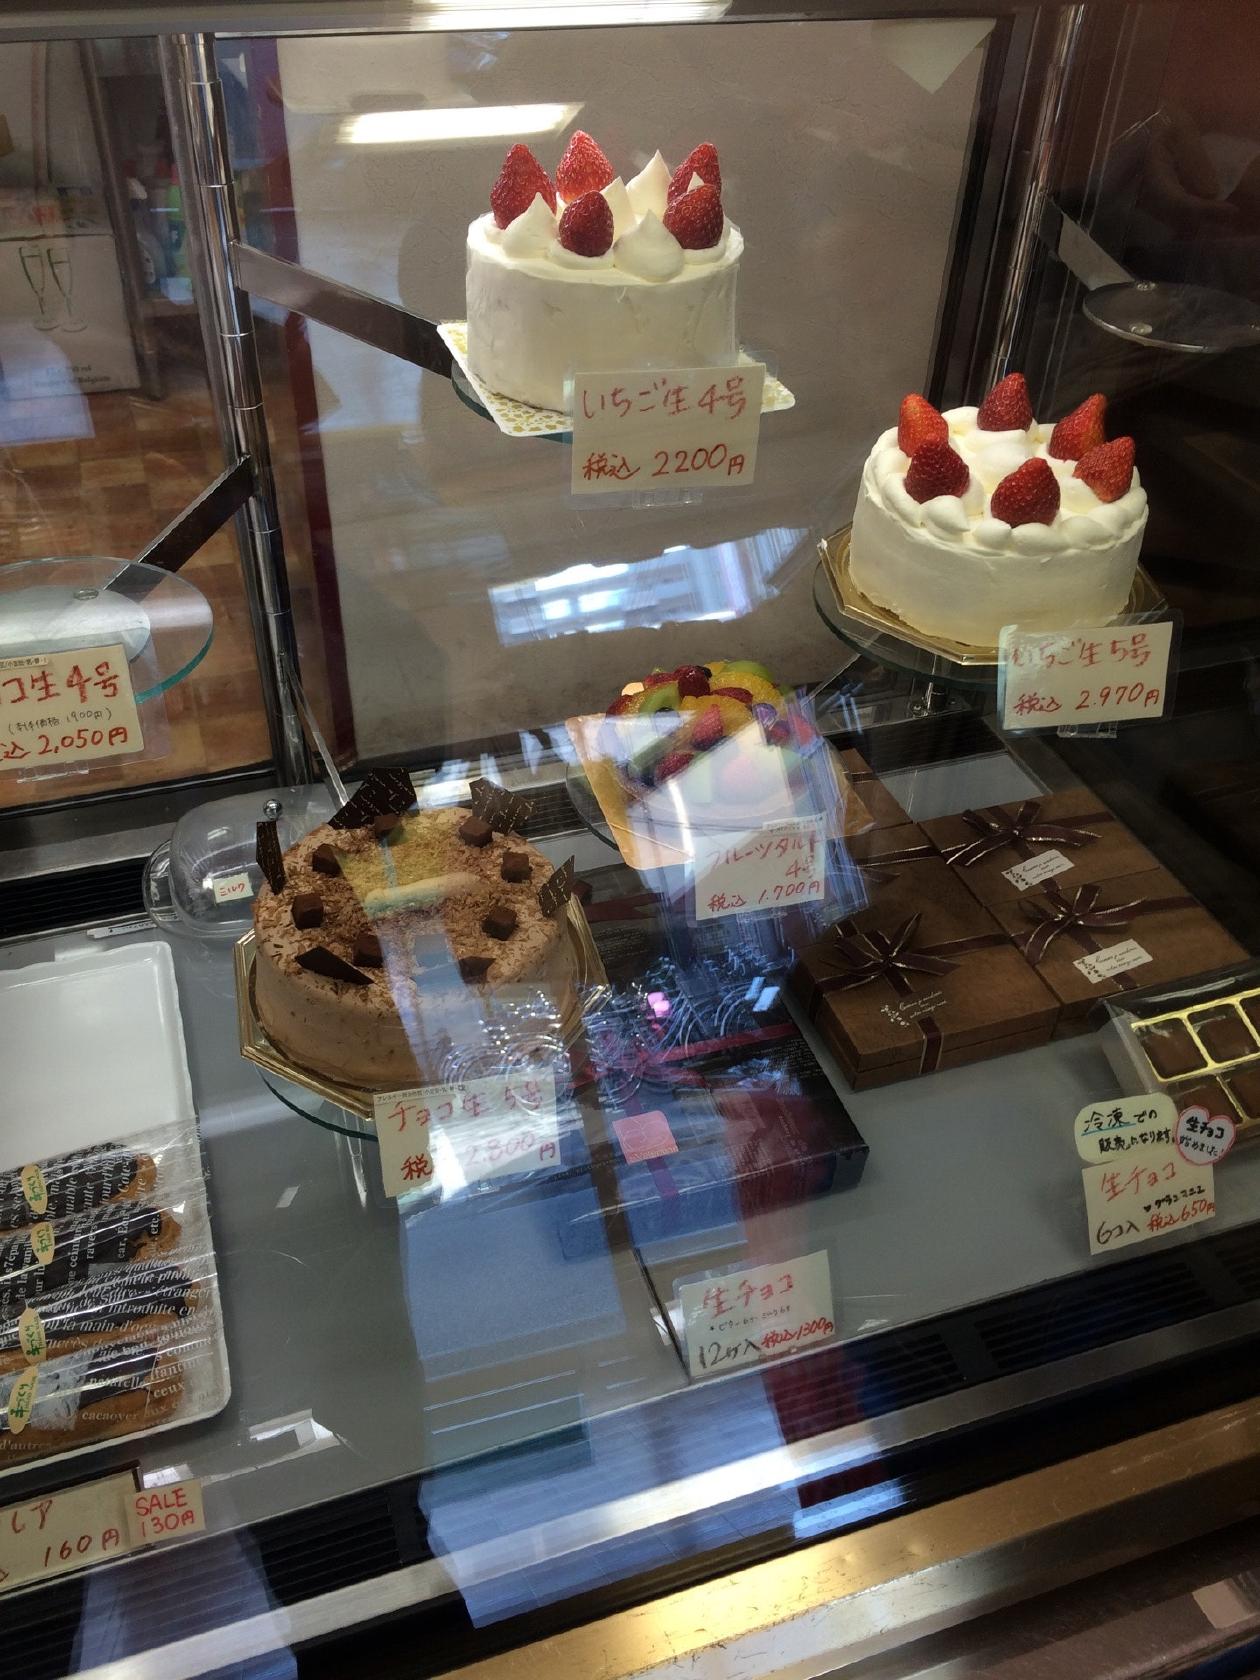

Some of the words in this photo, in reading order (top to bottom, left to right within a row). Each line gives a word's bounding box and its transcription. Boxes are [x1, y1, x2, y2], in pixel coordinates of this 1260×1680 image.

[582, 451, 640, 480] 税込
[652, 443, 744, 476] 2200円
[0, 661, 119, 704] コ生4号
[1013, 691, 1062, 716] 税込
[706, 892, 747, 912] 税込
[1185, 1115, 1225, 1140] 生チョコ
[1100, 1162, 1177, 1201] 生チョコ
[703, 1273, 794, 1318] 生チョコ
[135, 1487, 189, 1517] SALE
[141, 1510, 196, 1538] 130円
[44, 1528, 120, 1567] 160円
